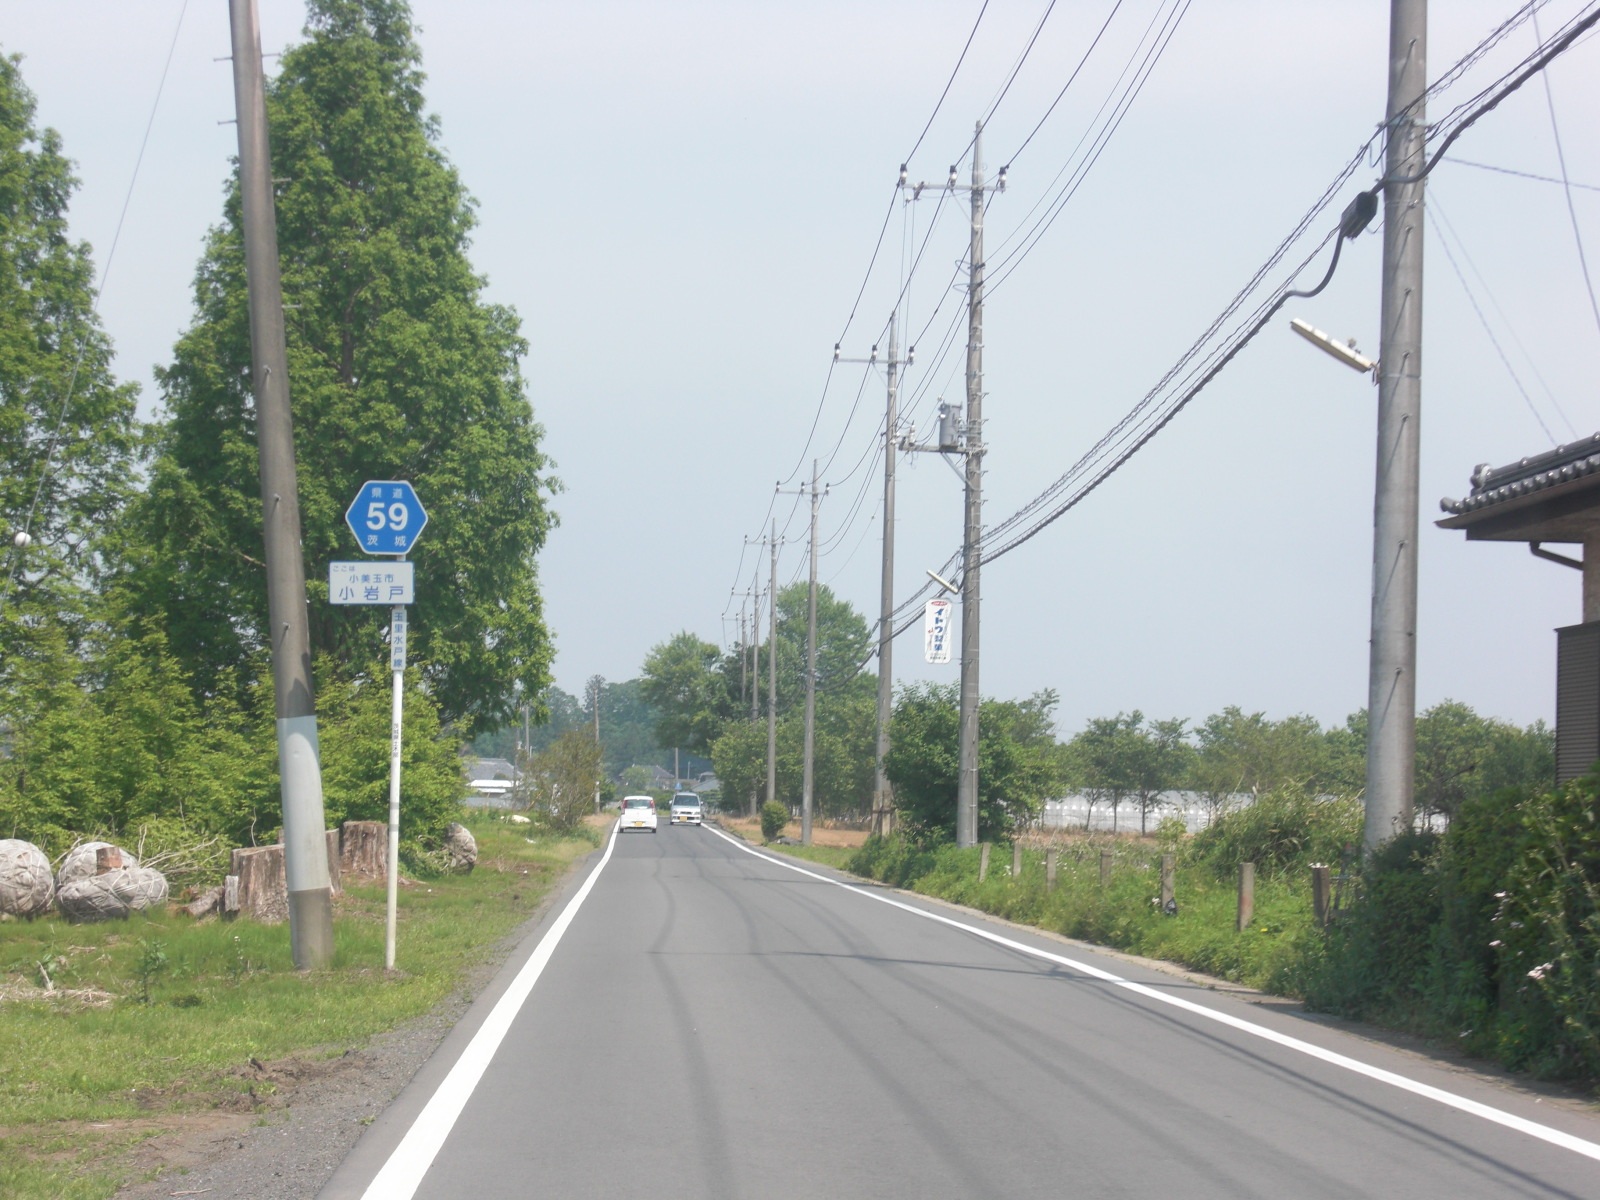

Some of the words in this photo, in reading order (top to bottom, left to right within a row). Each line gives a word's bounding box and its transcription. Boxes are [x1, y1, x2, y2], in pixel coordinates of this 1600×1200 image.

[372, 487, 403, 498] 県道
[366, 502, 408, 531] 59
[367, 535, 406, 546] 茨城
[349, 574, 394, 583] 小美玉市
[339, 585, 404, 601] 小岩戸
[394, 612, 403, 668] 玉里水戸線
